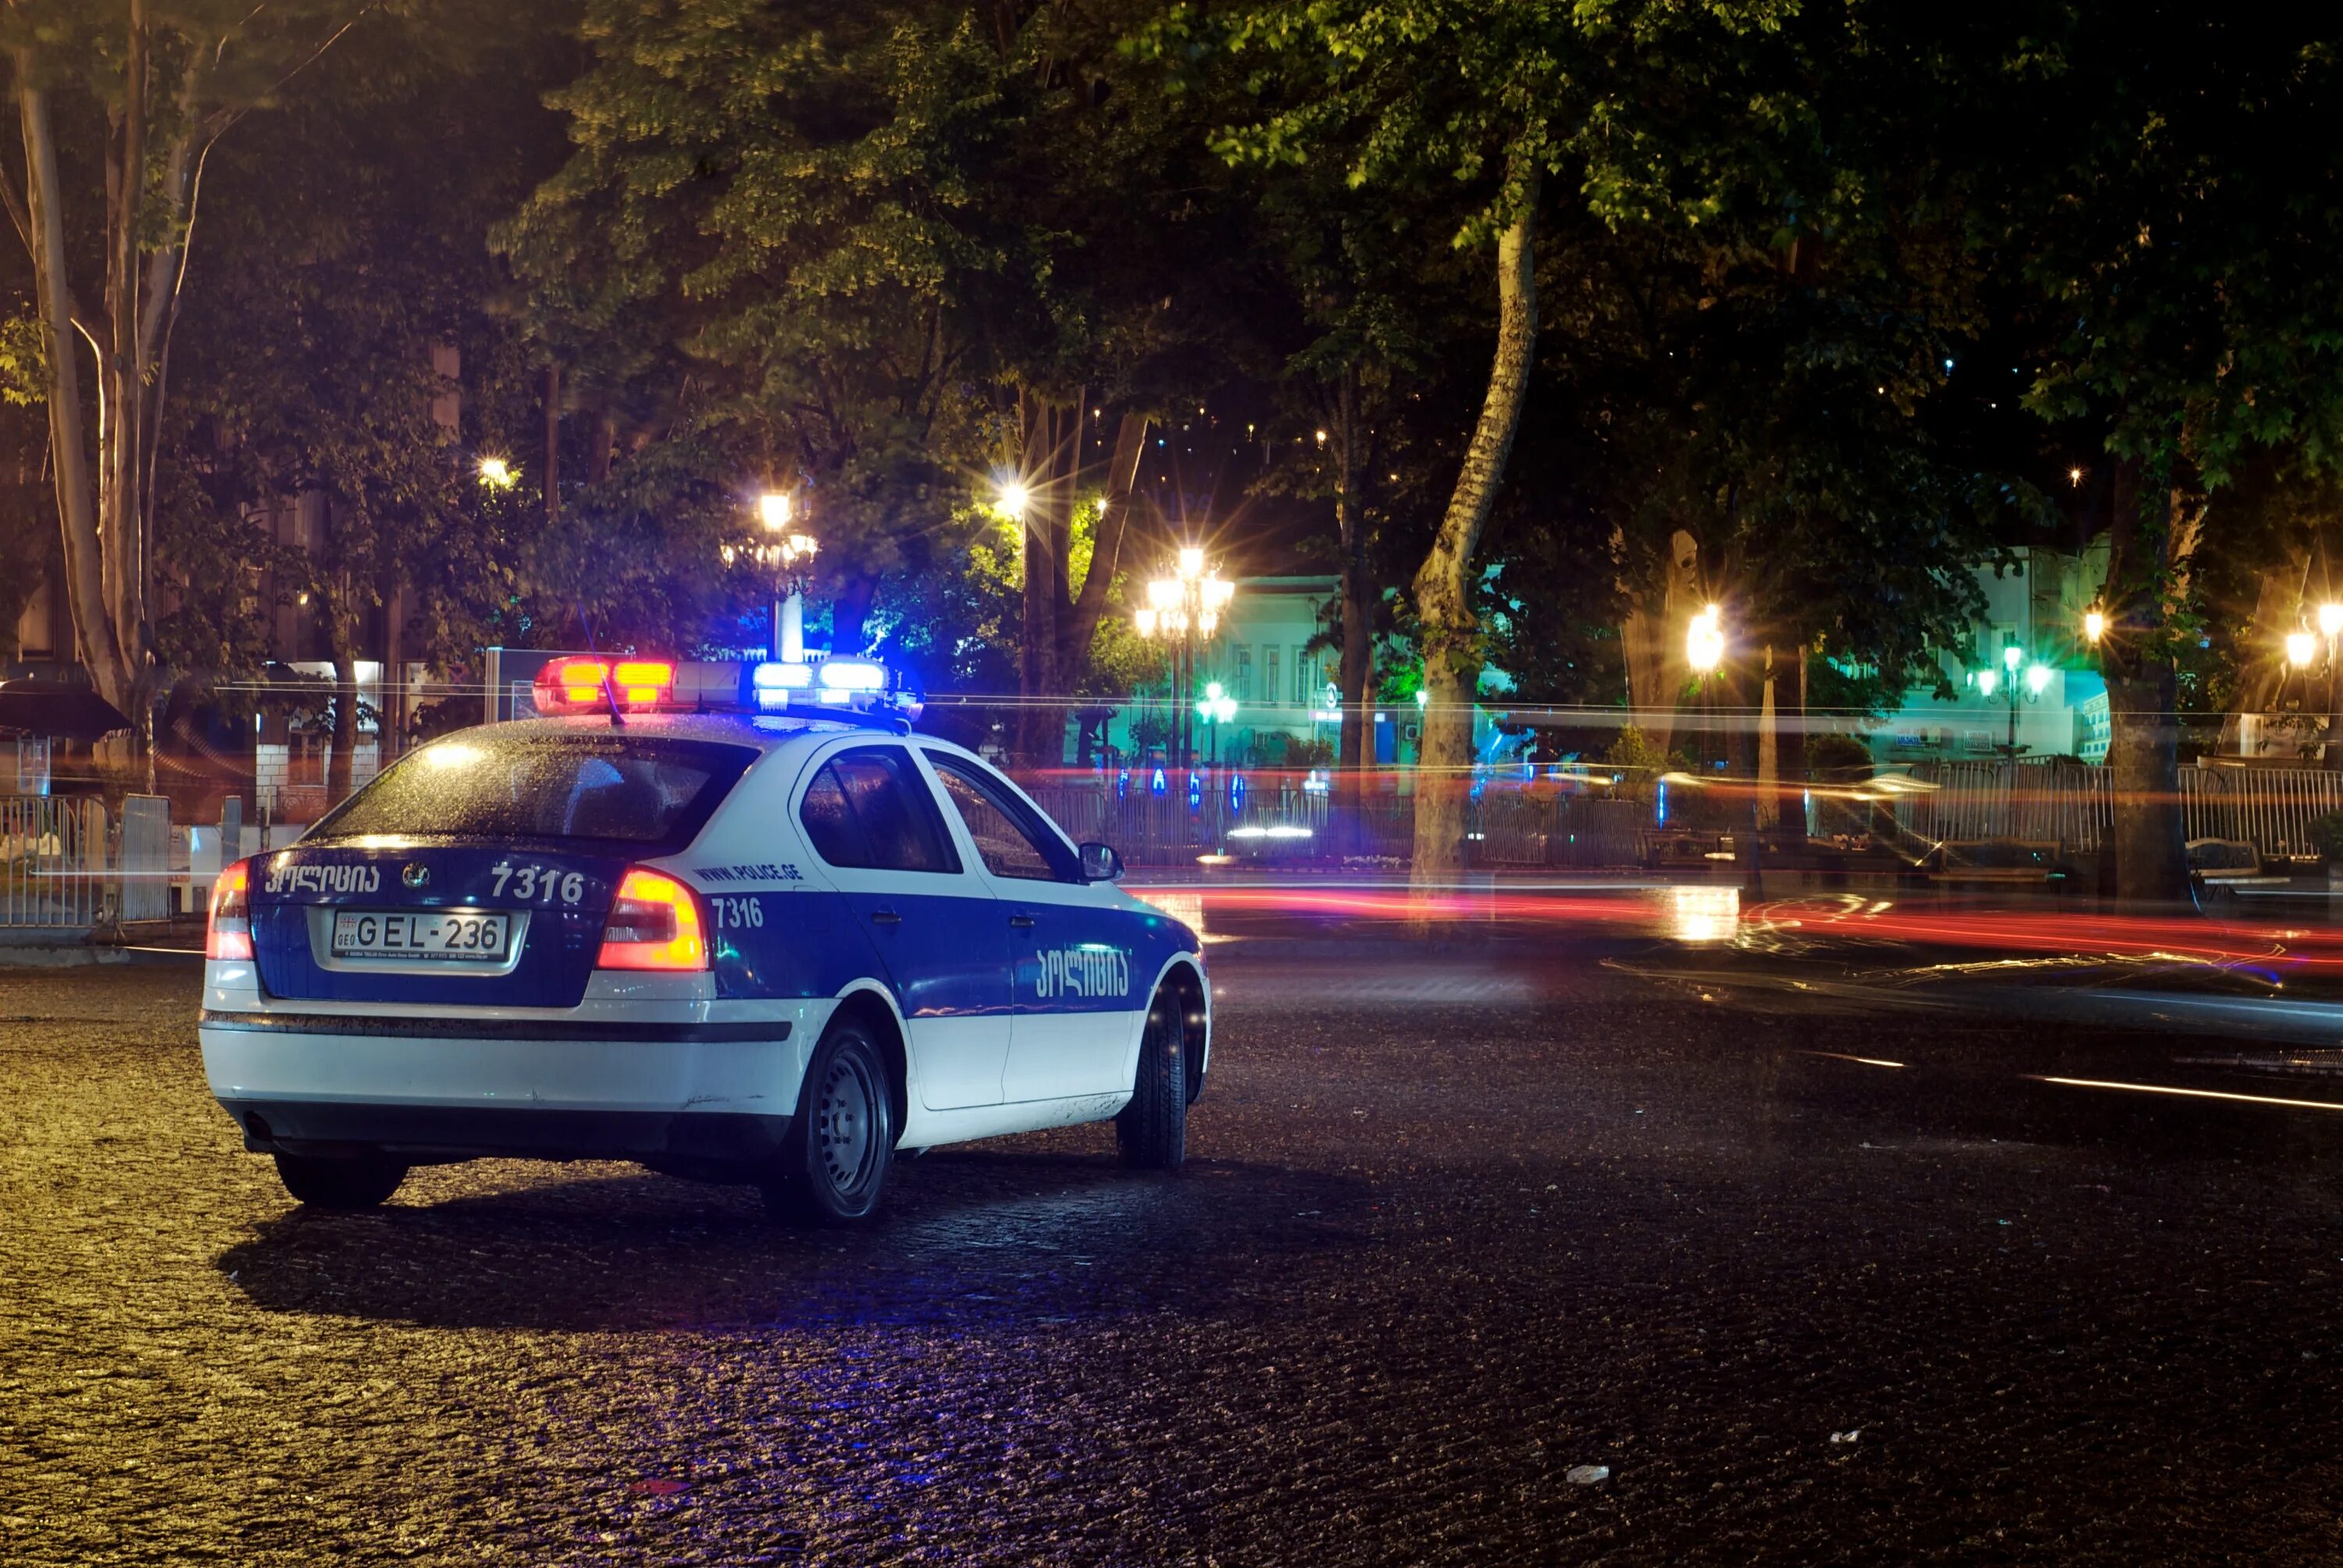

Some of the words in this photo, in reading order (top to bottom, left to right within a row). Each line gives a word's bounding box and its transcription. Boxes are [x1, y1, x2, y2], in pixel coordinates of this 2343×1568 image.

[265, 865, 380, 893] პოლიცია
[491, 867, 584, 903] 7316
[693, 864, 804, 882] WWW.POLICE.GE
[711, 897, 763, 928] 7316
[337, 933, 355, 946] GEO
[357, 916, 498, 950] GEL-236
[1036, 950, 1129, 997] პოლიცია
